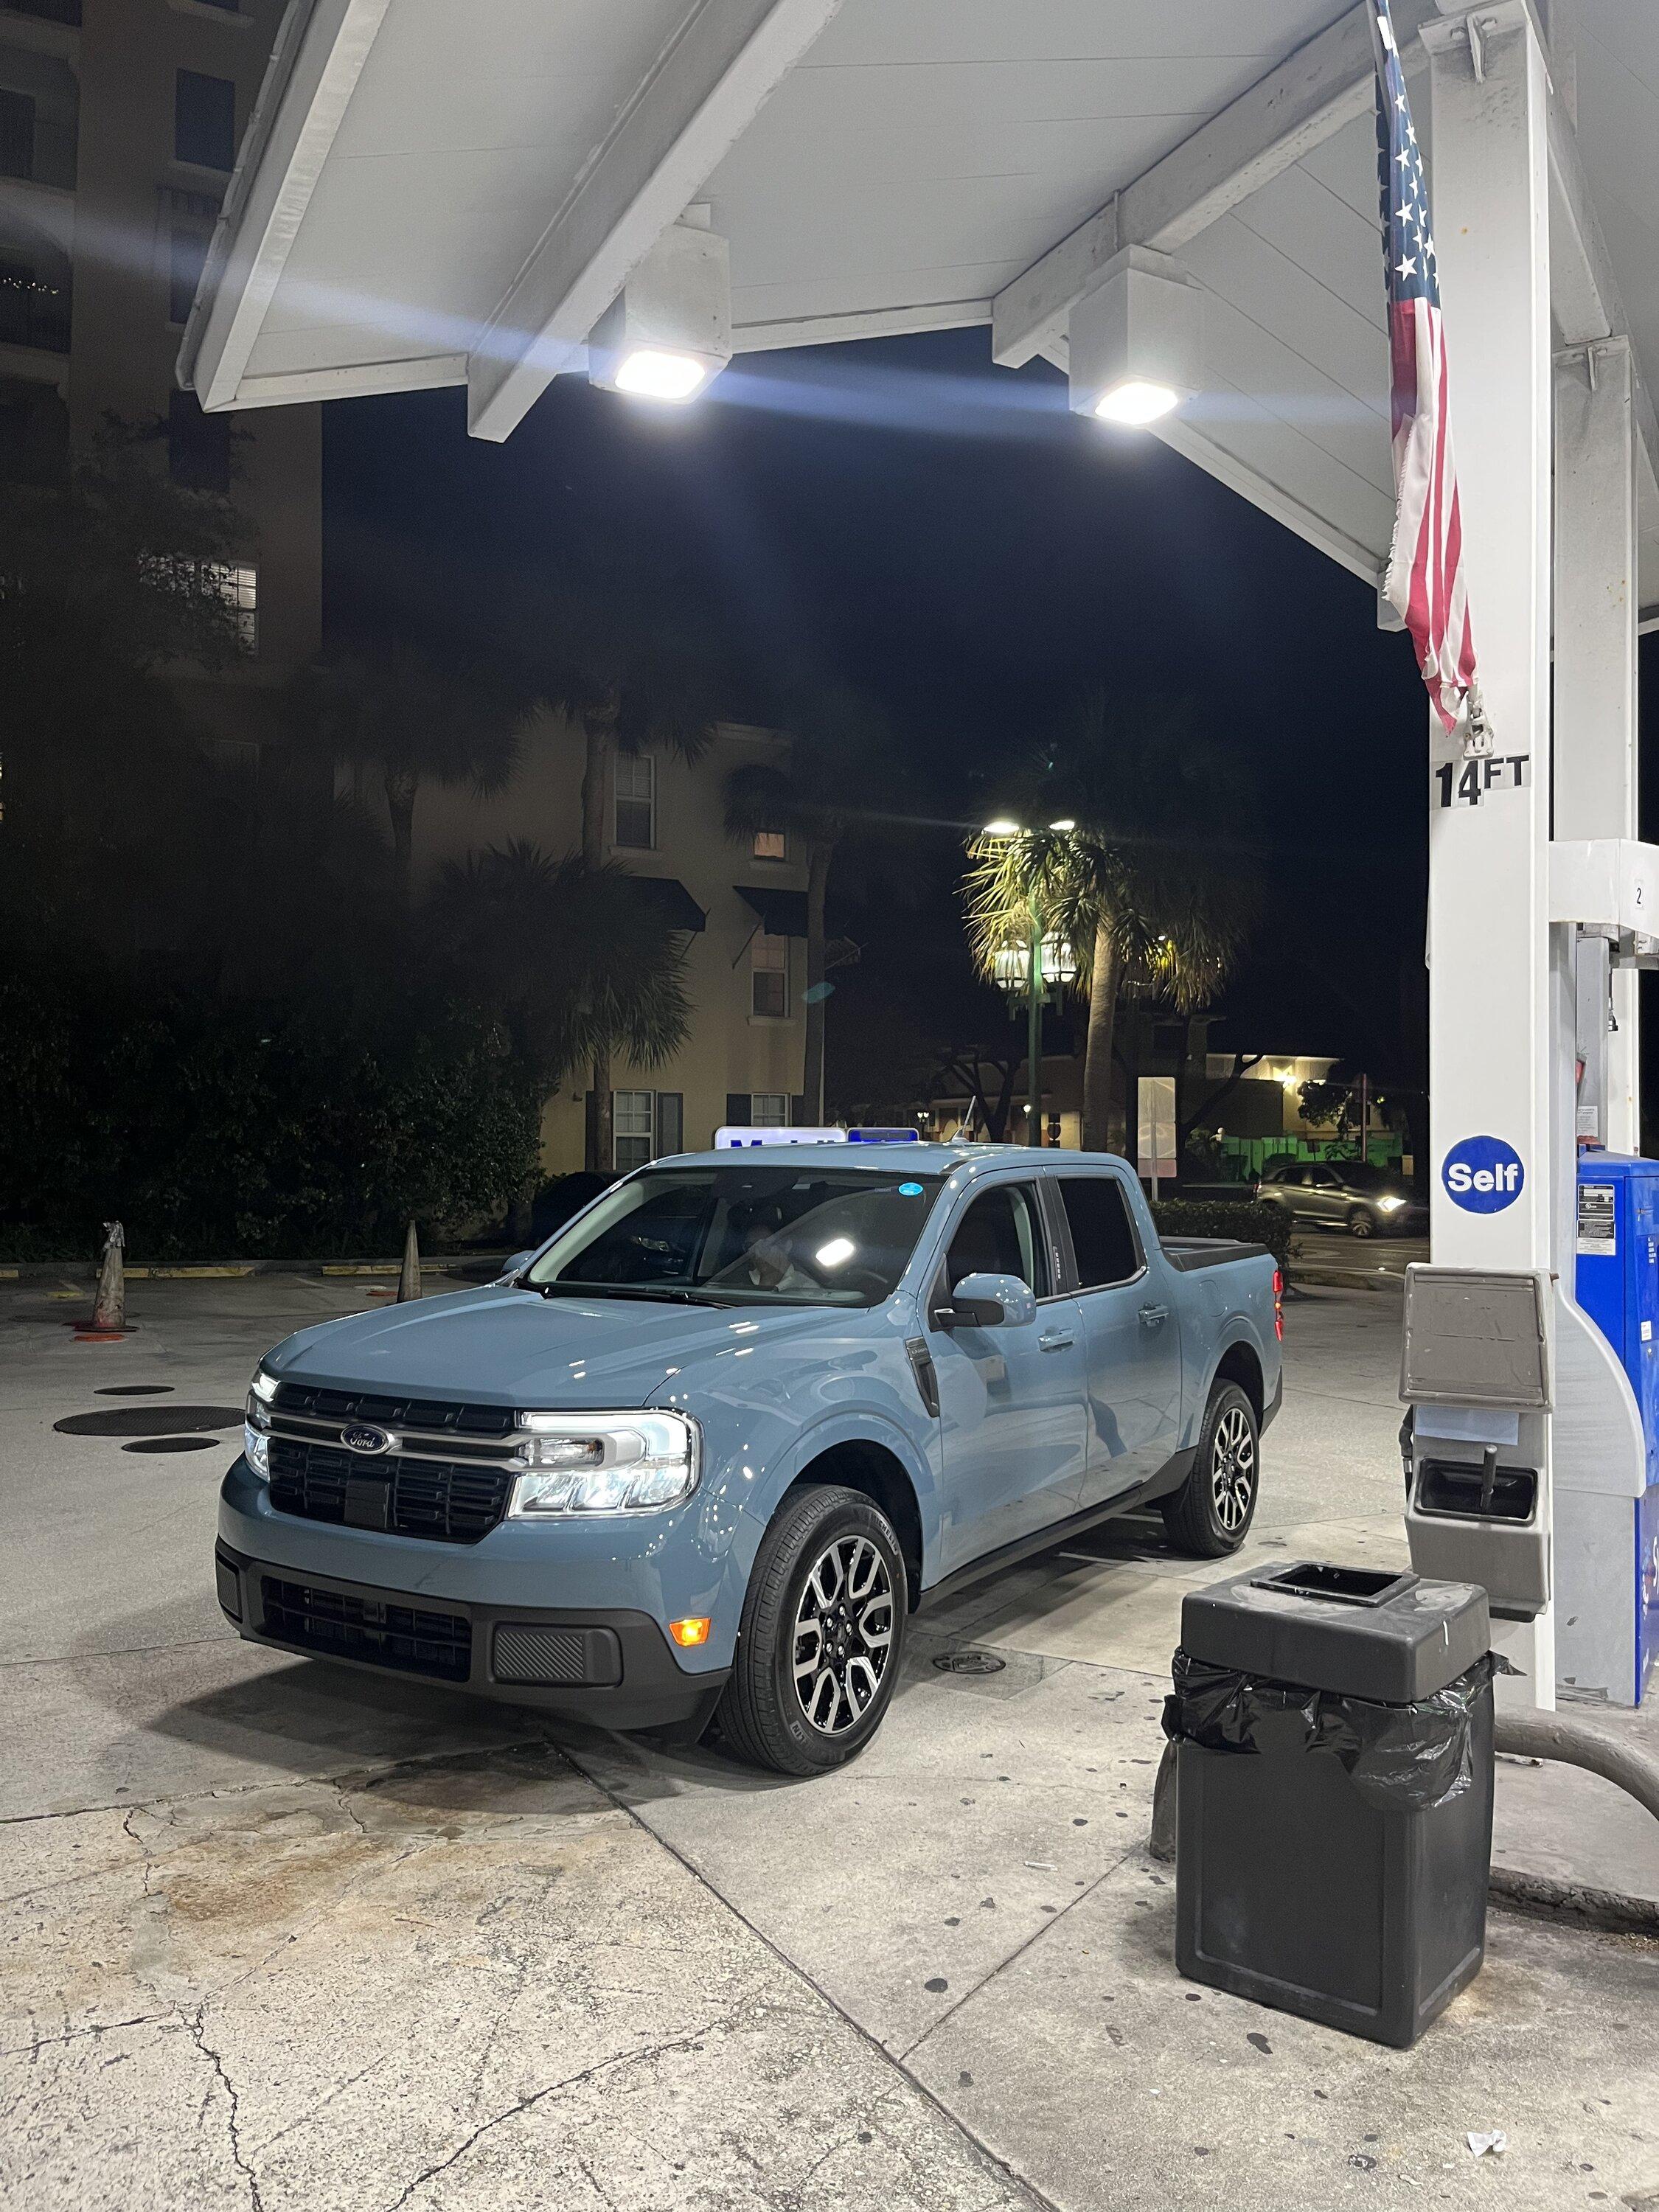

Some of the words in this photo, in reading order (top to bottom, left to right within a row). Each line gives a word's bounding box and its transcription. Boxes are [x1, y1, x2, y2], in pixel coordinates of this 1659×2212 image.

[1636, 887, 1641, 905] 2
[1447, 1163, 1518, 1192] Self
[349, 1431, 375, 1448] Ford
